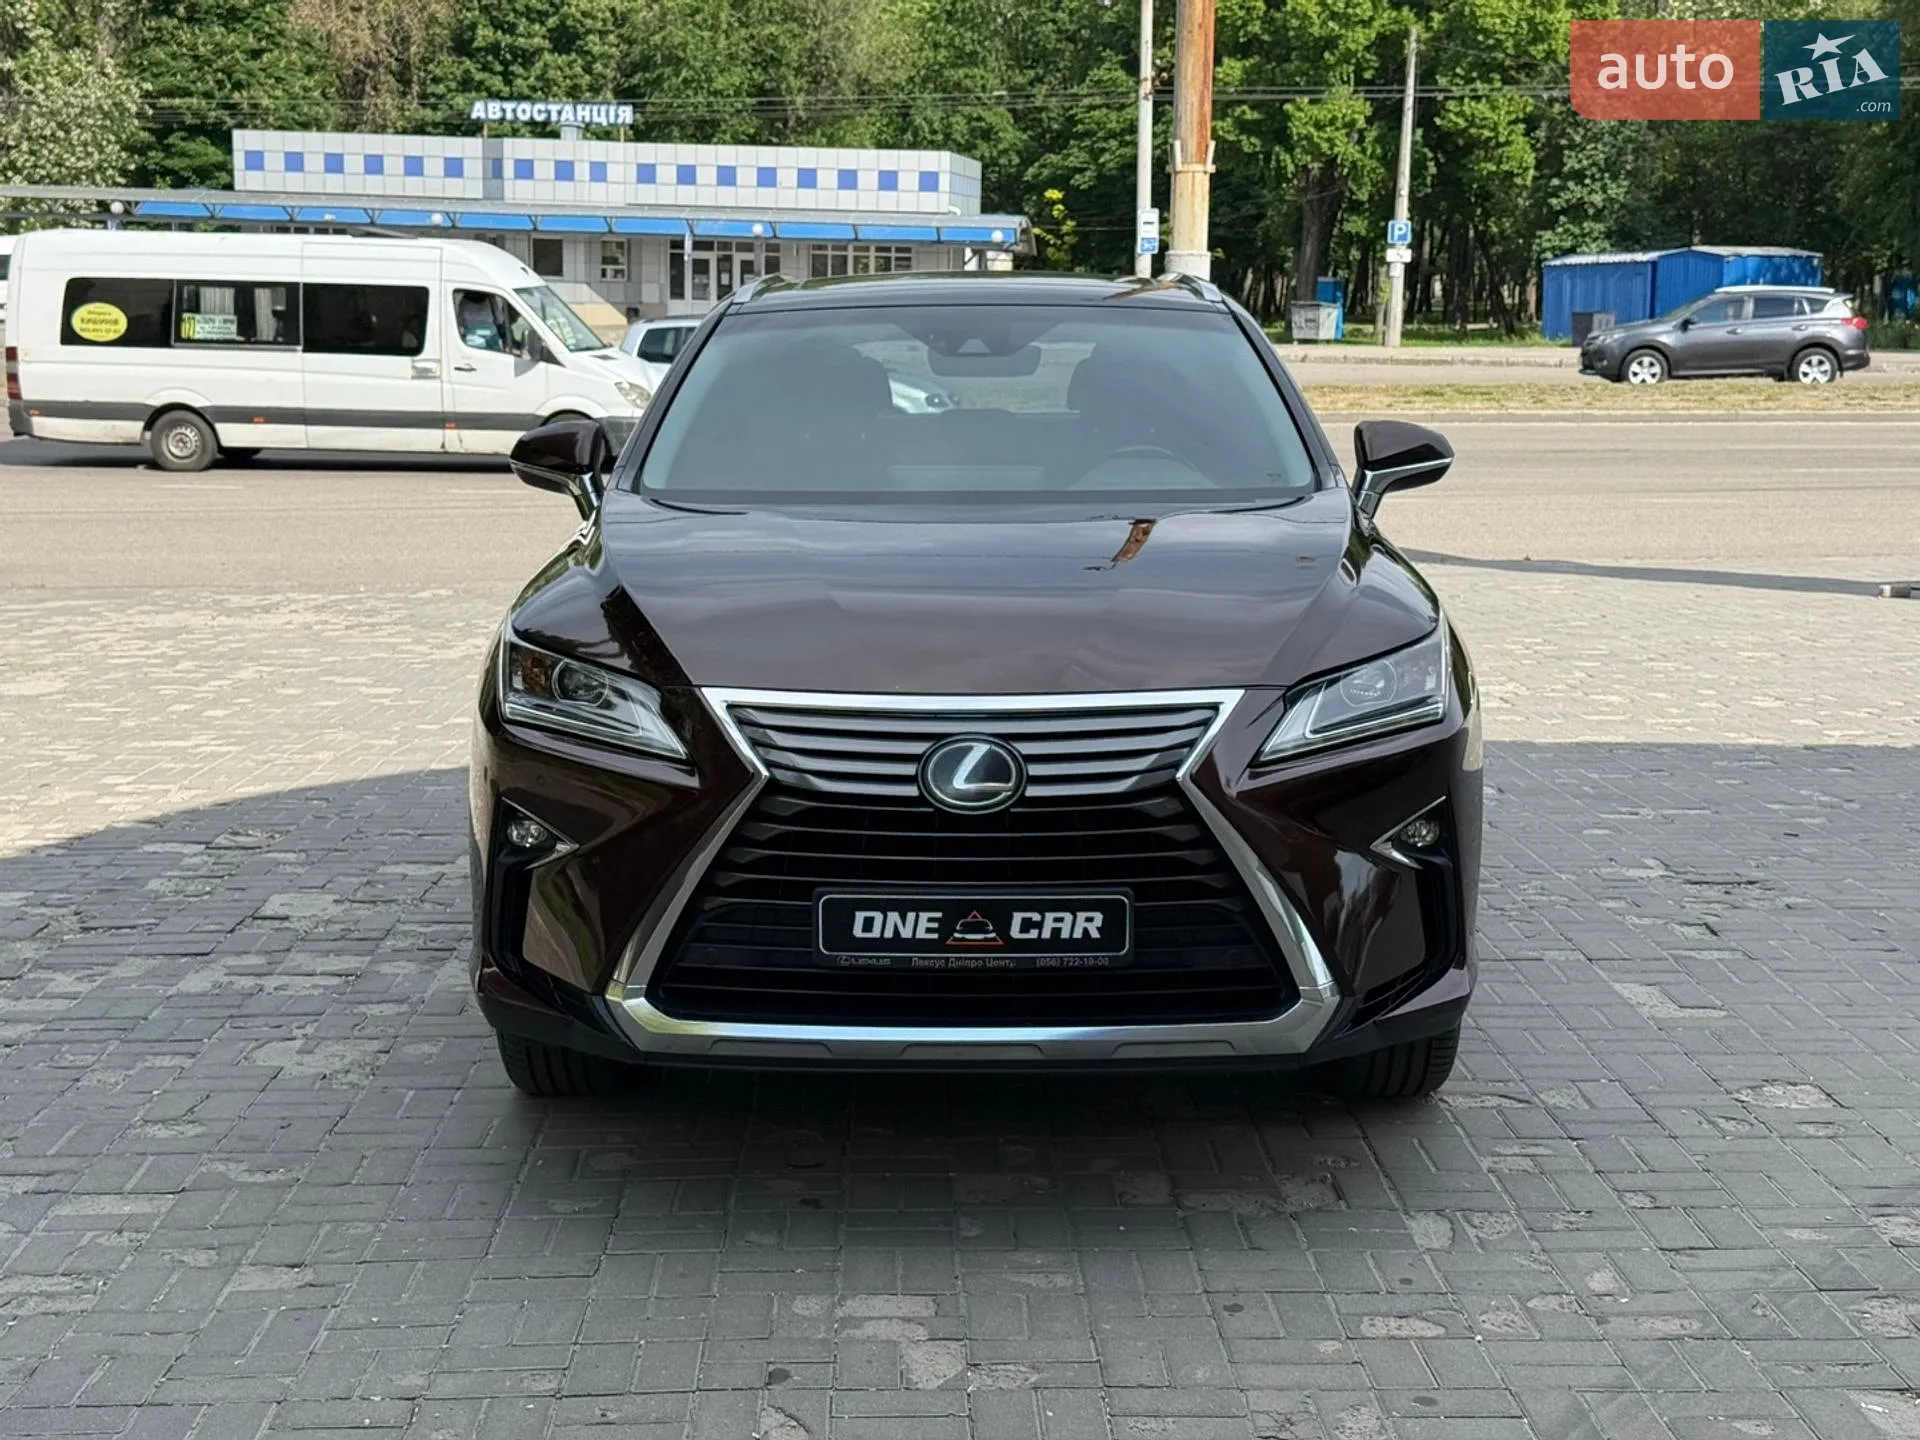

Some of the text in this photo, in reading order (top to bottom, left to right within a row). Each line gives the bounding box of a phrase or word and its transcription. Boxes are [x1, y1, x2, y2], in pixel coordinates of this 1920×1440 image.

[470, 99, 634, 126] АВТОСТАНЦІЯ
[852, 910, 1104, 939] ONE CAR
